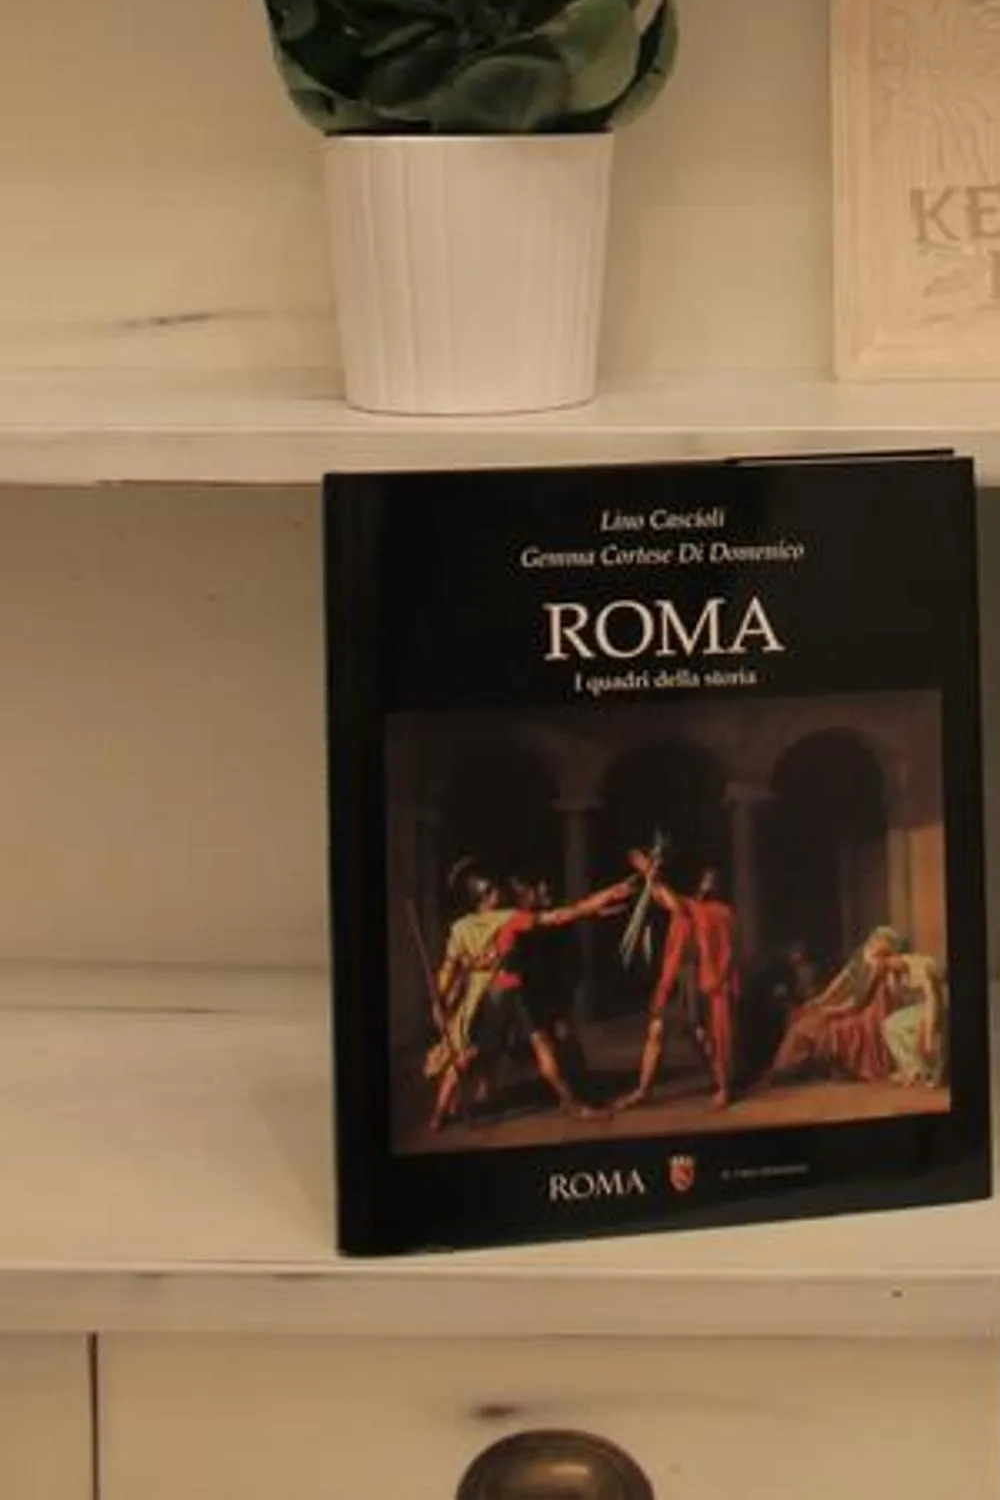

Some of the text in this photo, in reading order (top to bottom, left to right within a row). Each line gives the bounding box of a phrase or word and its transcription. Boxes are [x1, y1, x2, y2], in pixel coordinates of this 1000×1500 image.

[601, 509, 644, 531] Lino
[543, 596, 784, 661] ROMA
[574, 669, 757, 695] I quadri della storia
[549, 1169, 645, 1201] ROMA
